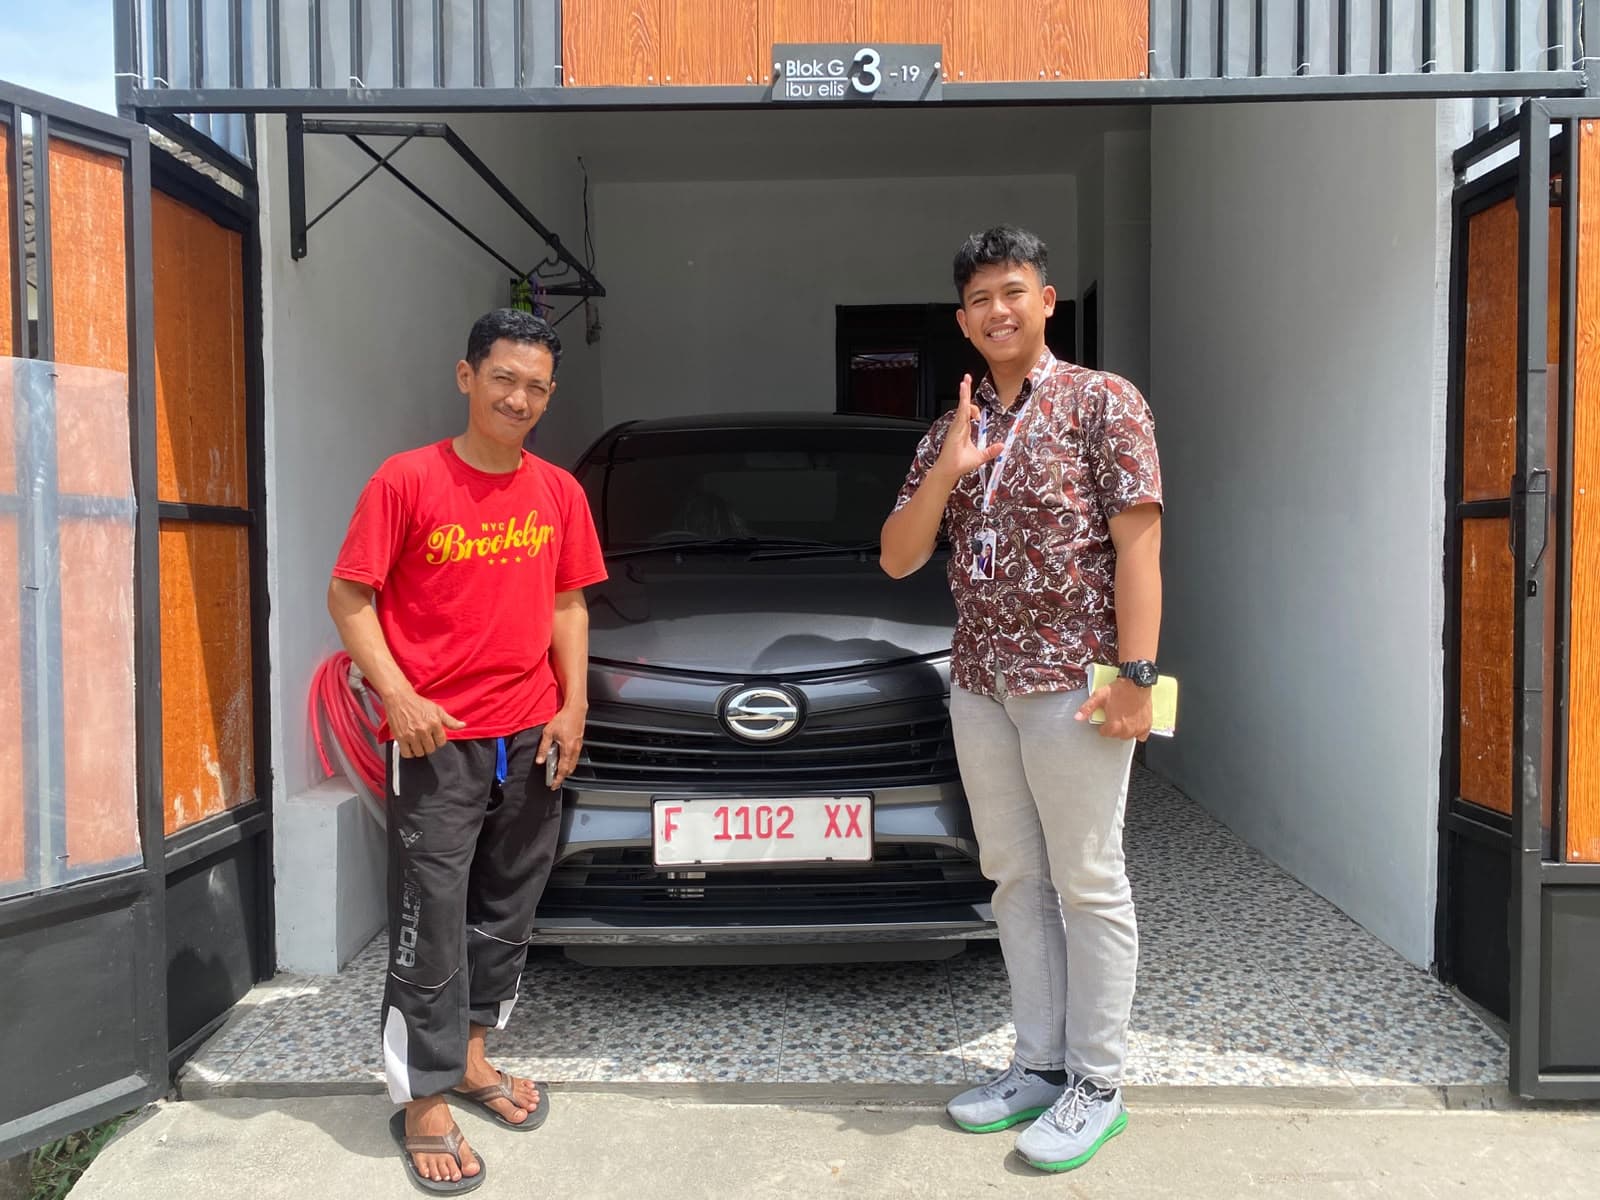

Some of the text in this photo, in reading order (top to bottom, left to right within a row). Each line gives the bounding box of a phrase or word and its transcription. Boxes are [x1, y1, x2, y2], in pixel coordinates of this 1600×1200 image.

[786, 60, 844, 76] Blok G
[852, 48, 881, 93] 3
[786, 81, 845, 97] Ibu elis
[426, 510, 555, 564] Brooklyn
[482, 522, 504, 531] NYC
[664, 804, 863, 842] F 1102 XX
[396, 868, 421, 967] ICTOR
